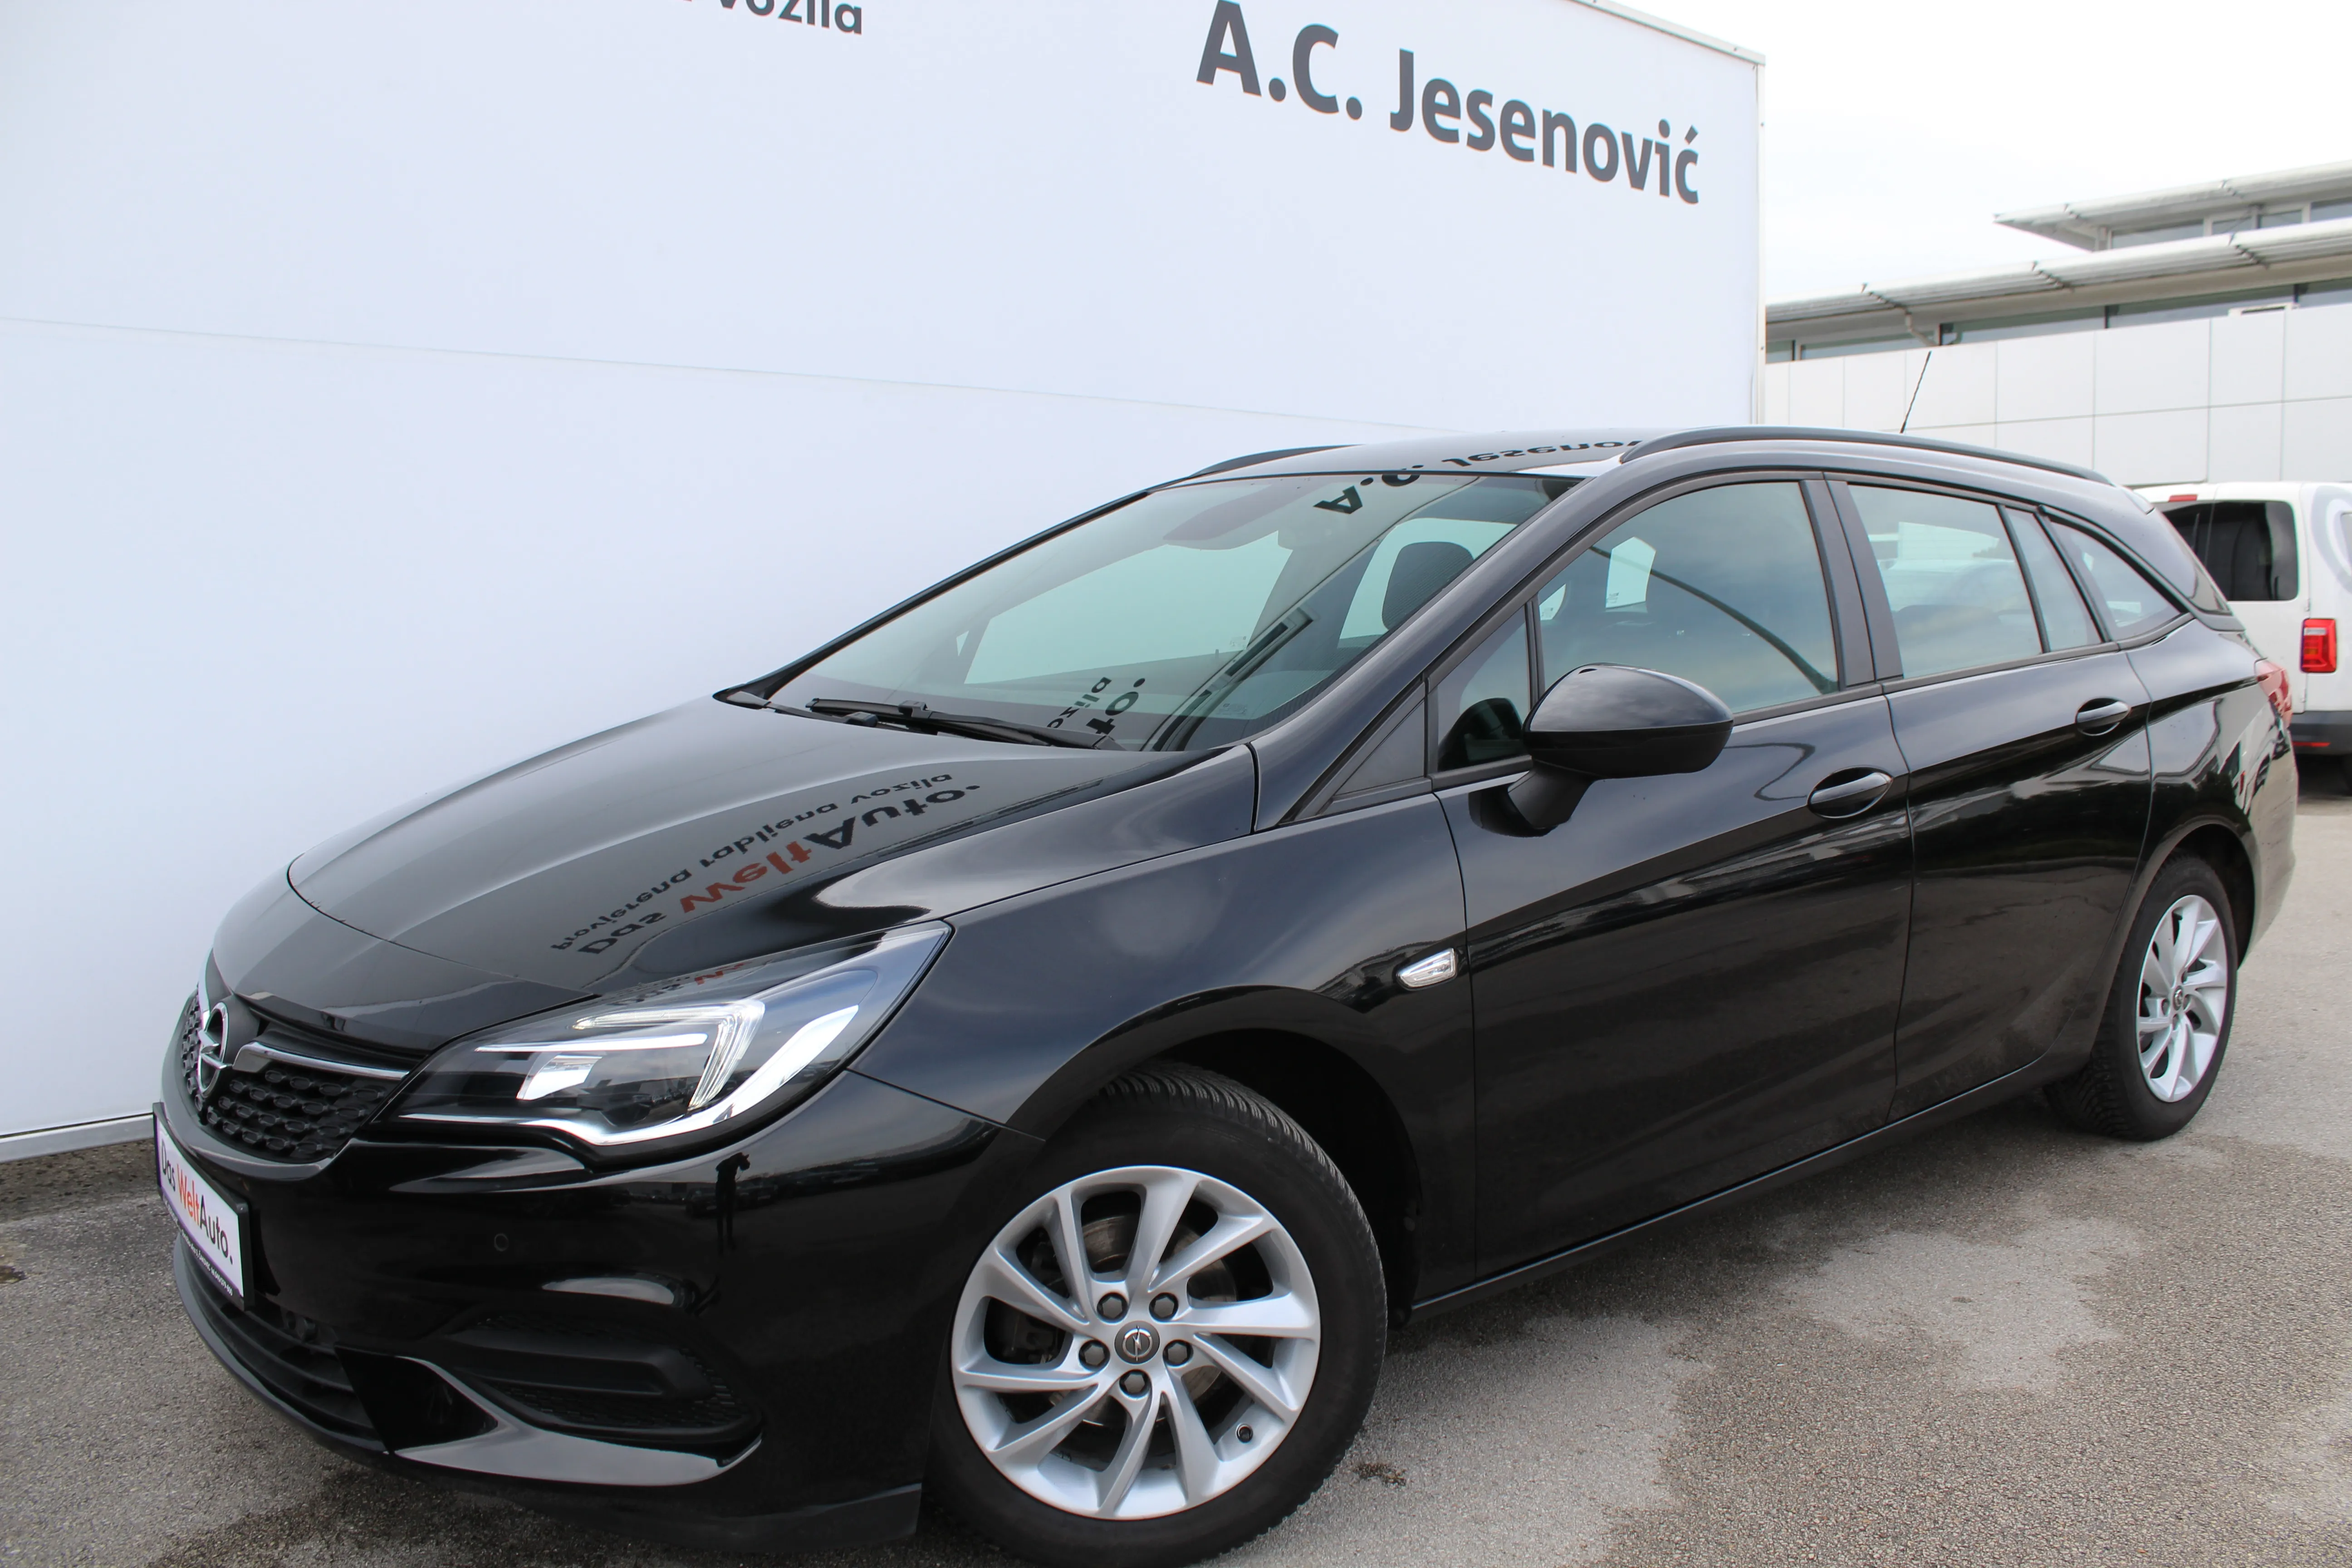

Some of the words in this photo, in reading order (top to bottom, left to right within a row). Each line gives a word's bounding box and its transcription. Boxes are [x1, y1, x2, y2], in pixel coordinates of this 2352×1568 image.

[1196, 0, 1362, 120] A.C.
[1389, 47, 1699, 205] Jesenović
[162, 1137, 176, 1192] Das
